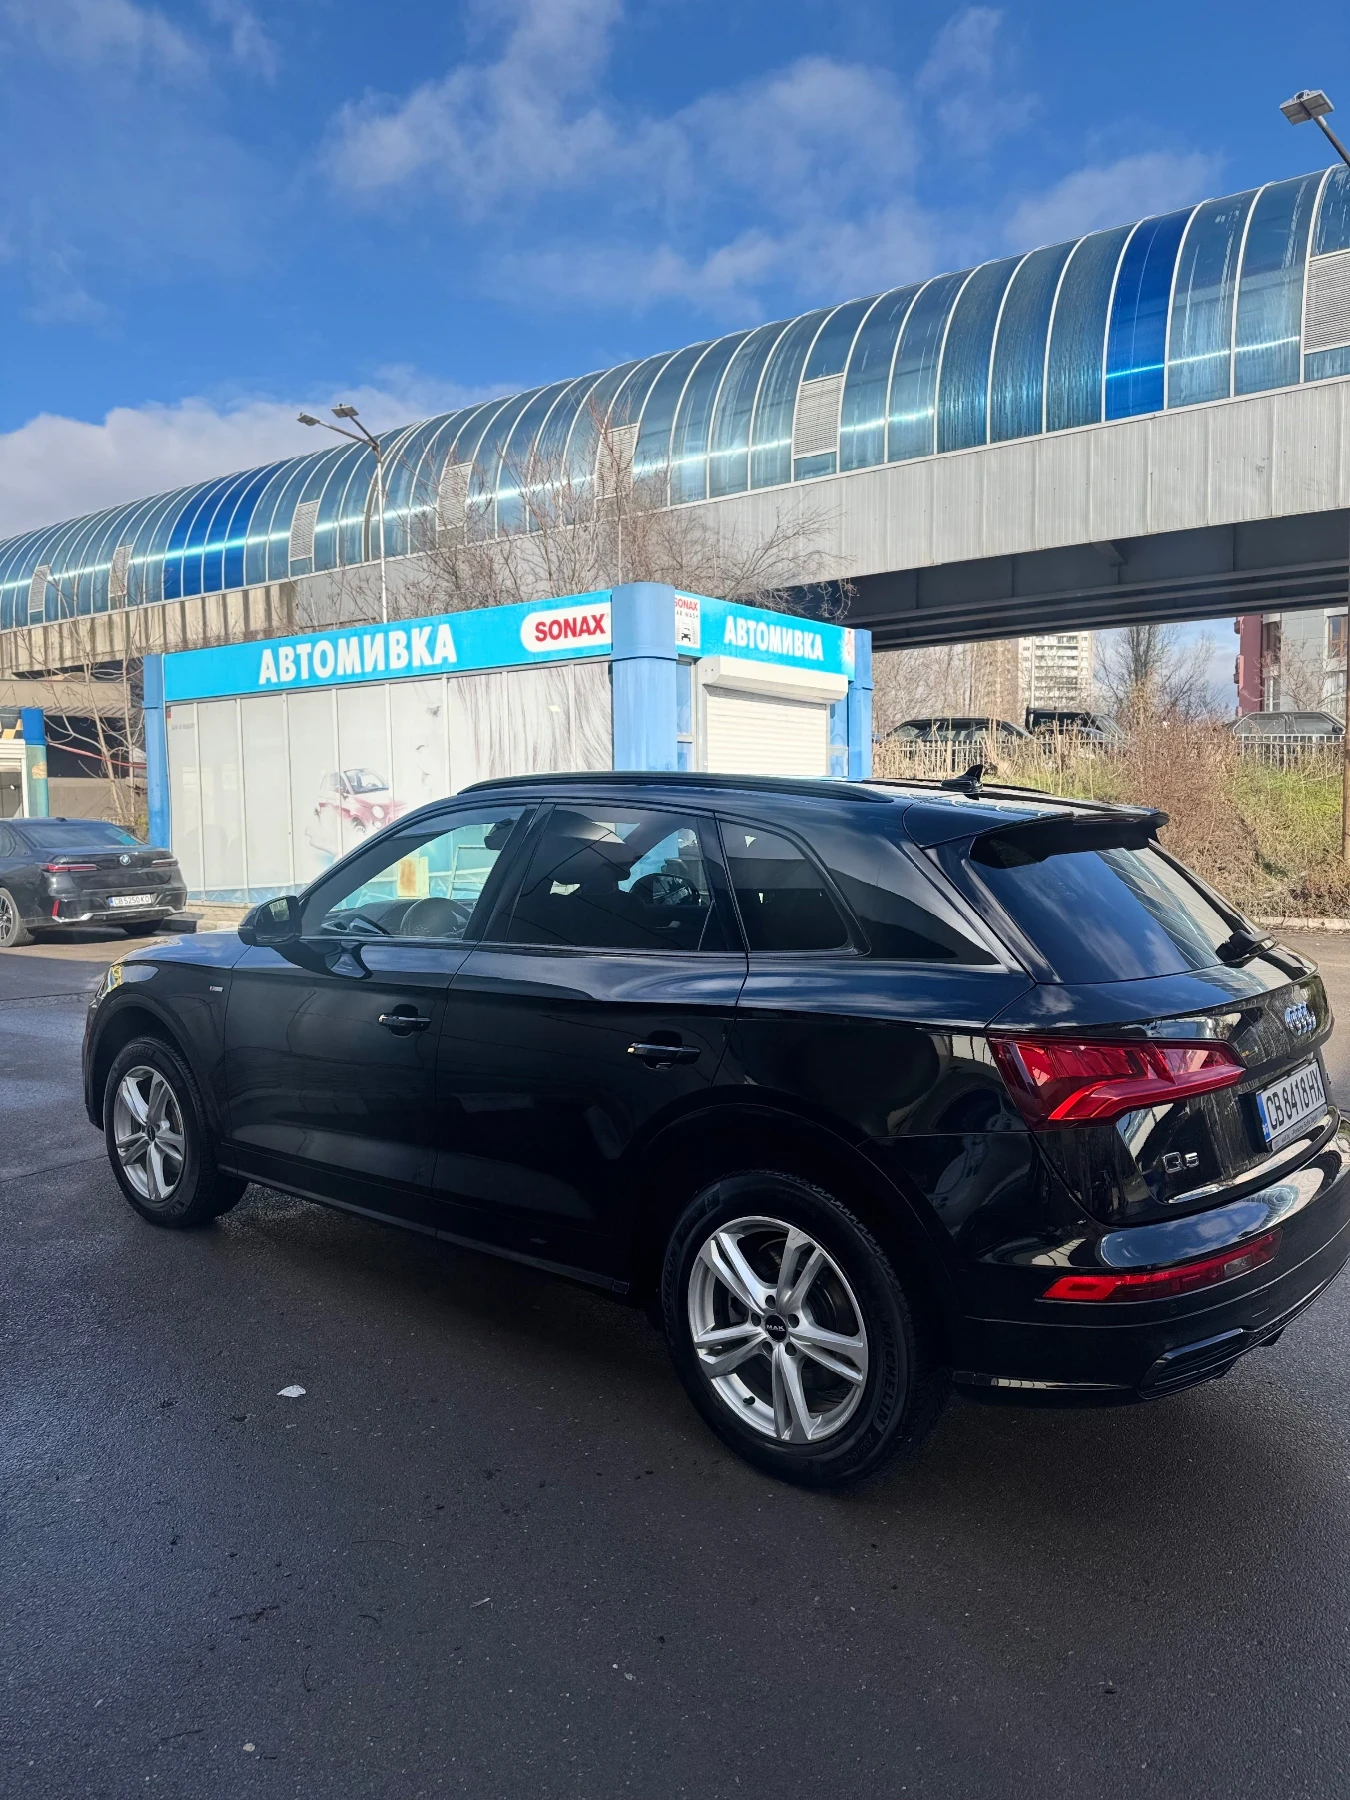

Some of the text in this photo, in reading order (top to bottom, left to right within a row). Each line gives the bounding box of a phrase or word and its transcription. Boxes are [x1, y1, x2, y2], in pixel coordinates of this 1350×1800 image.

[675, 598, 698, 611] SONAX
[535, 613, 606, 642] SONAX
[723, 615, 824, 661] АВТОМИВКА
[258, 624, 457, 685] АВТОМИВКА
[1161, 1151, 1199, 1173] Q5
[766, 1324, 785, 1332] MAK
